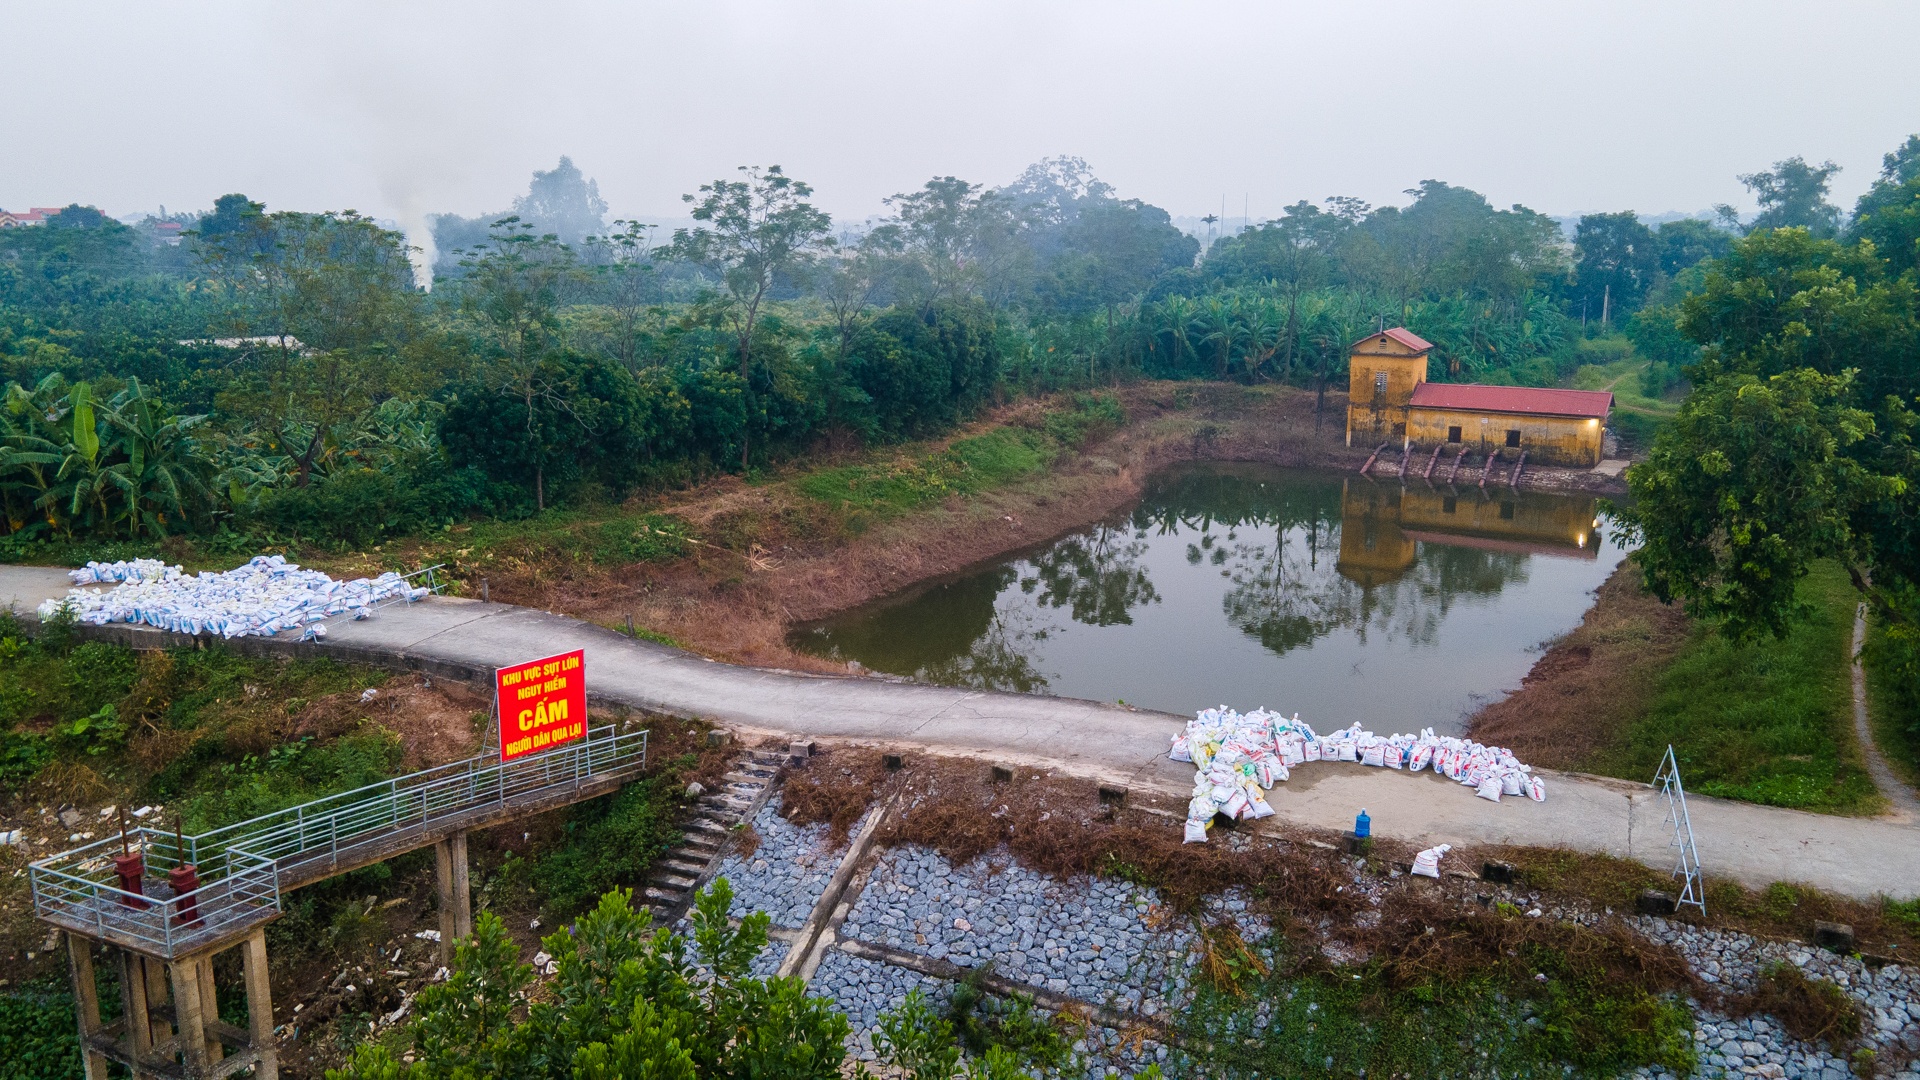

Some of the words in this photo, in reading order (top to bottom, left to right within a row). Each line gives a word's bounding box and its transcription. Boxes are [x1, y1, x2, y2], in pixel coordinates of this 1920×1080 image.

[503, 671, 521, 686] KHU
[524, 666, 541, 681] VỰC
[544, 662, 560, 676] SỤT
[562, 656, 579, 671] LÚN
[518, 684, 542, 700] NGUY
[544, 675, 566, 693] HIỂM
[518, 697, 568, 731] CẤM
[506, 735, 531, 756] NGƯỜI
[533, 732, 550, 748] DÂN
[552, 727, 568, 742] QUA
[570, 722, 581, 737] LẠI
